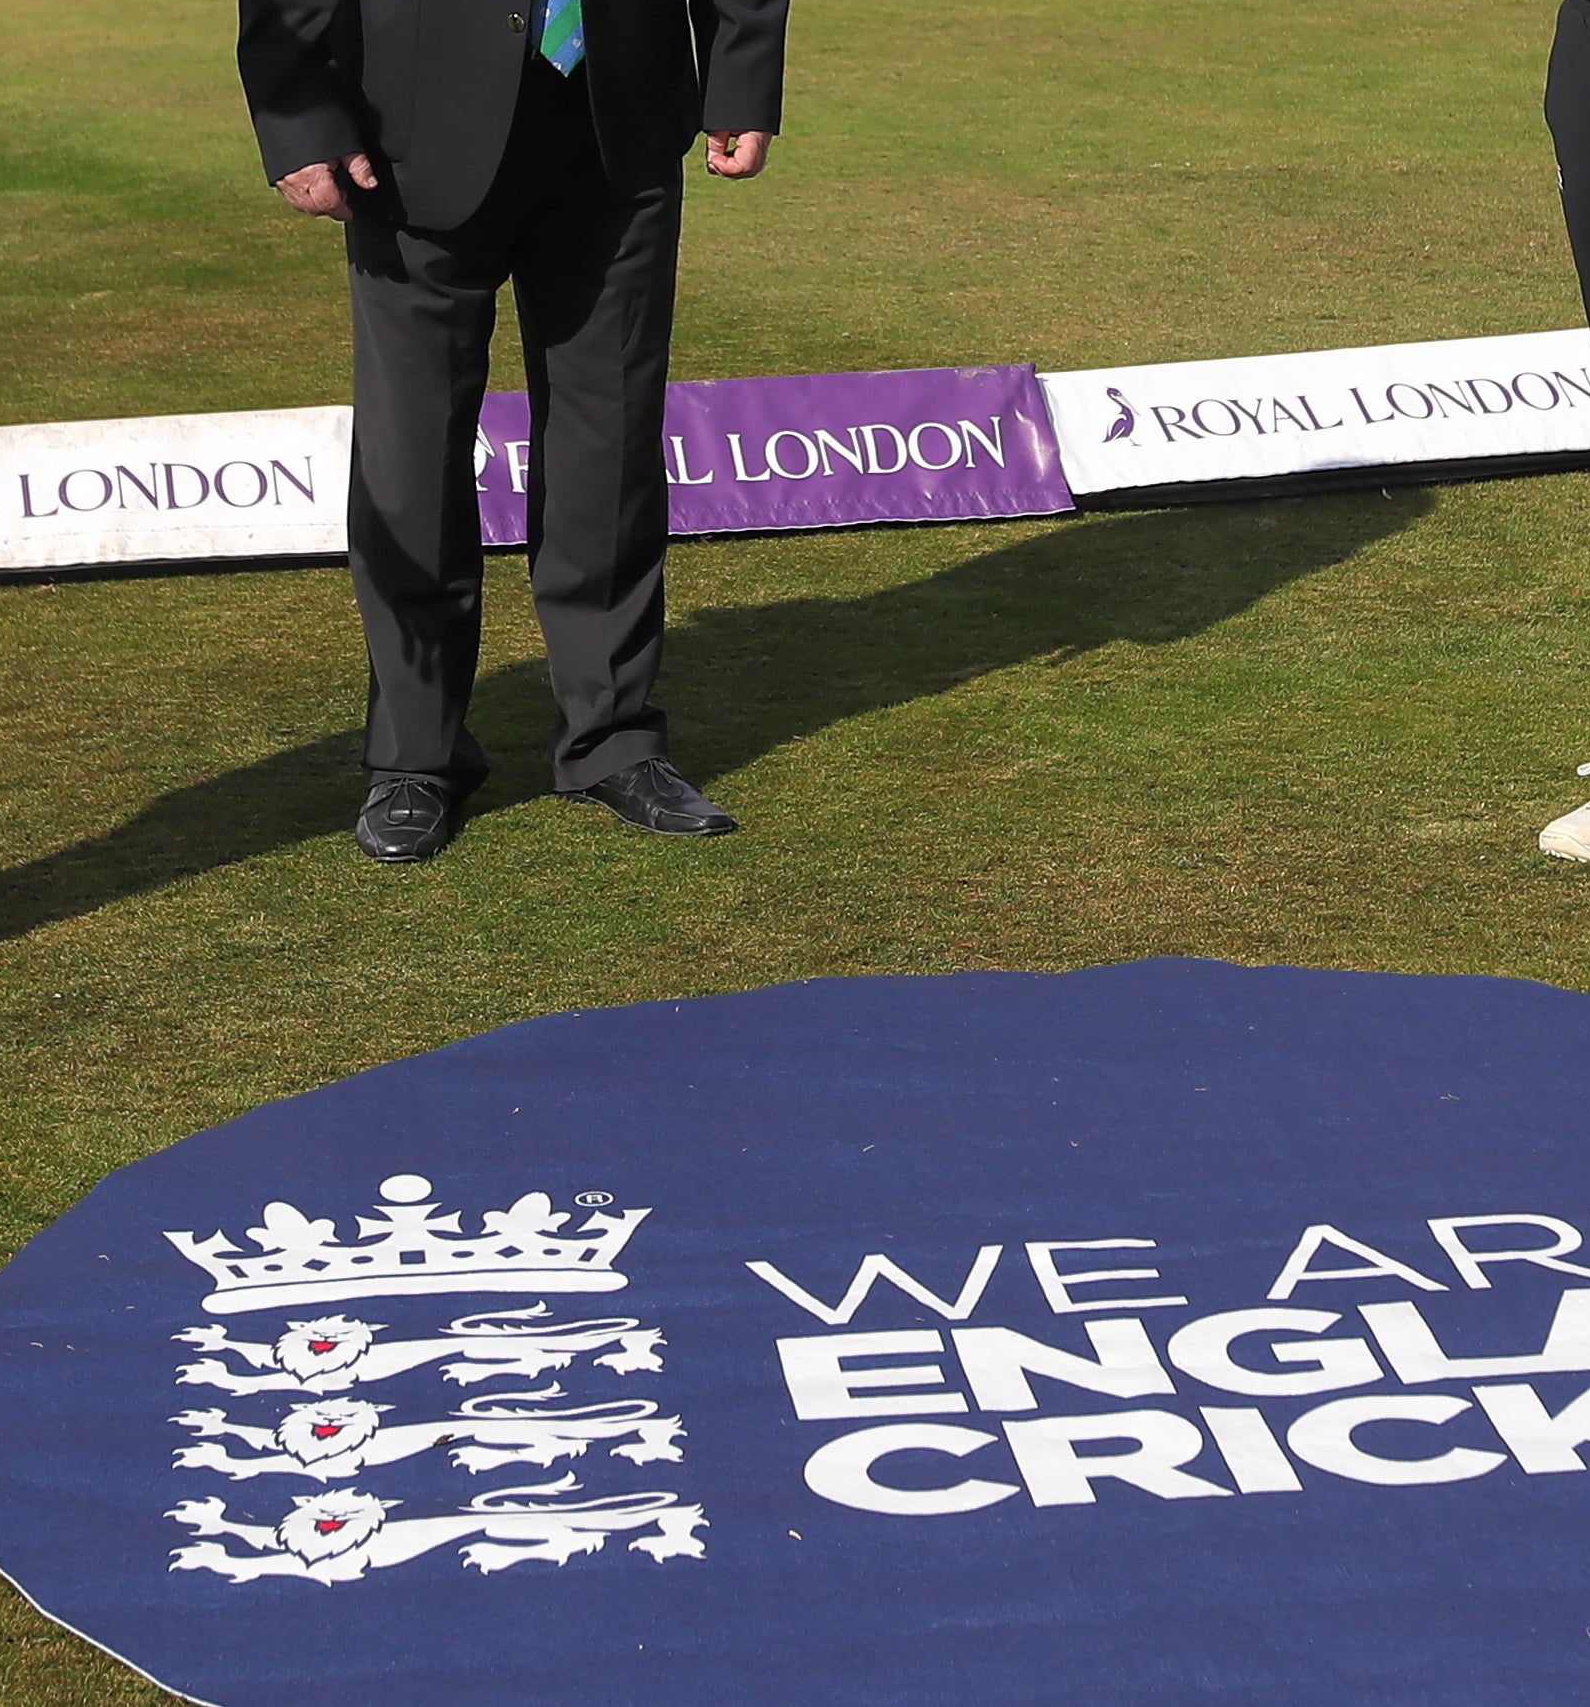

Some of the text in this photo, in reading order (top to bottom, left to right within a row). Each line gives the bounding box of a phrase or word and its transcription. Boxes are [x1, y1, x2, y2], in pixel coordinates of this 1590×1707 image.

[726, 416, 1007, 482] LONDON
[1150, 394, 1343, 443] ROYAL
[19, 455, 316, 519] LONDON
[744, 1238, 1189, 1326] WE
